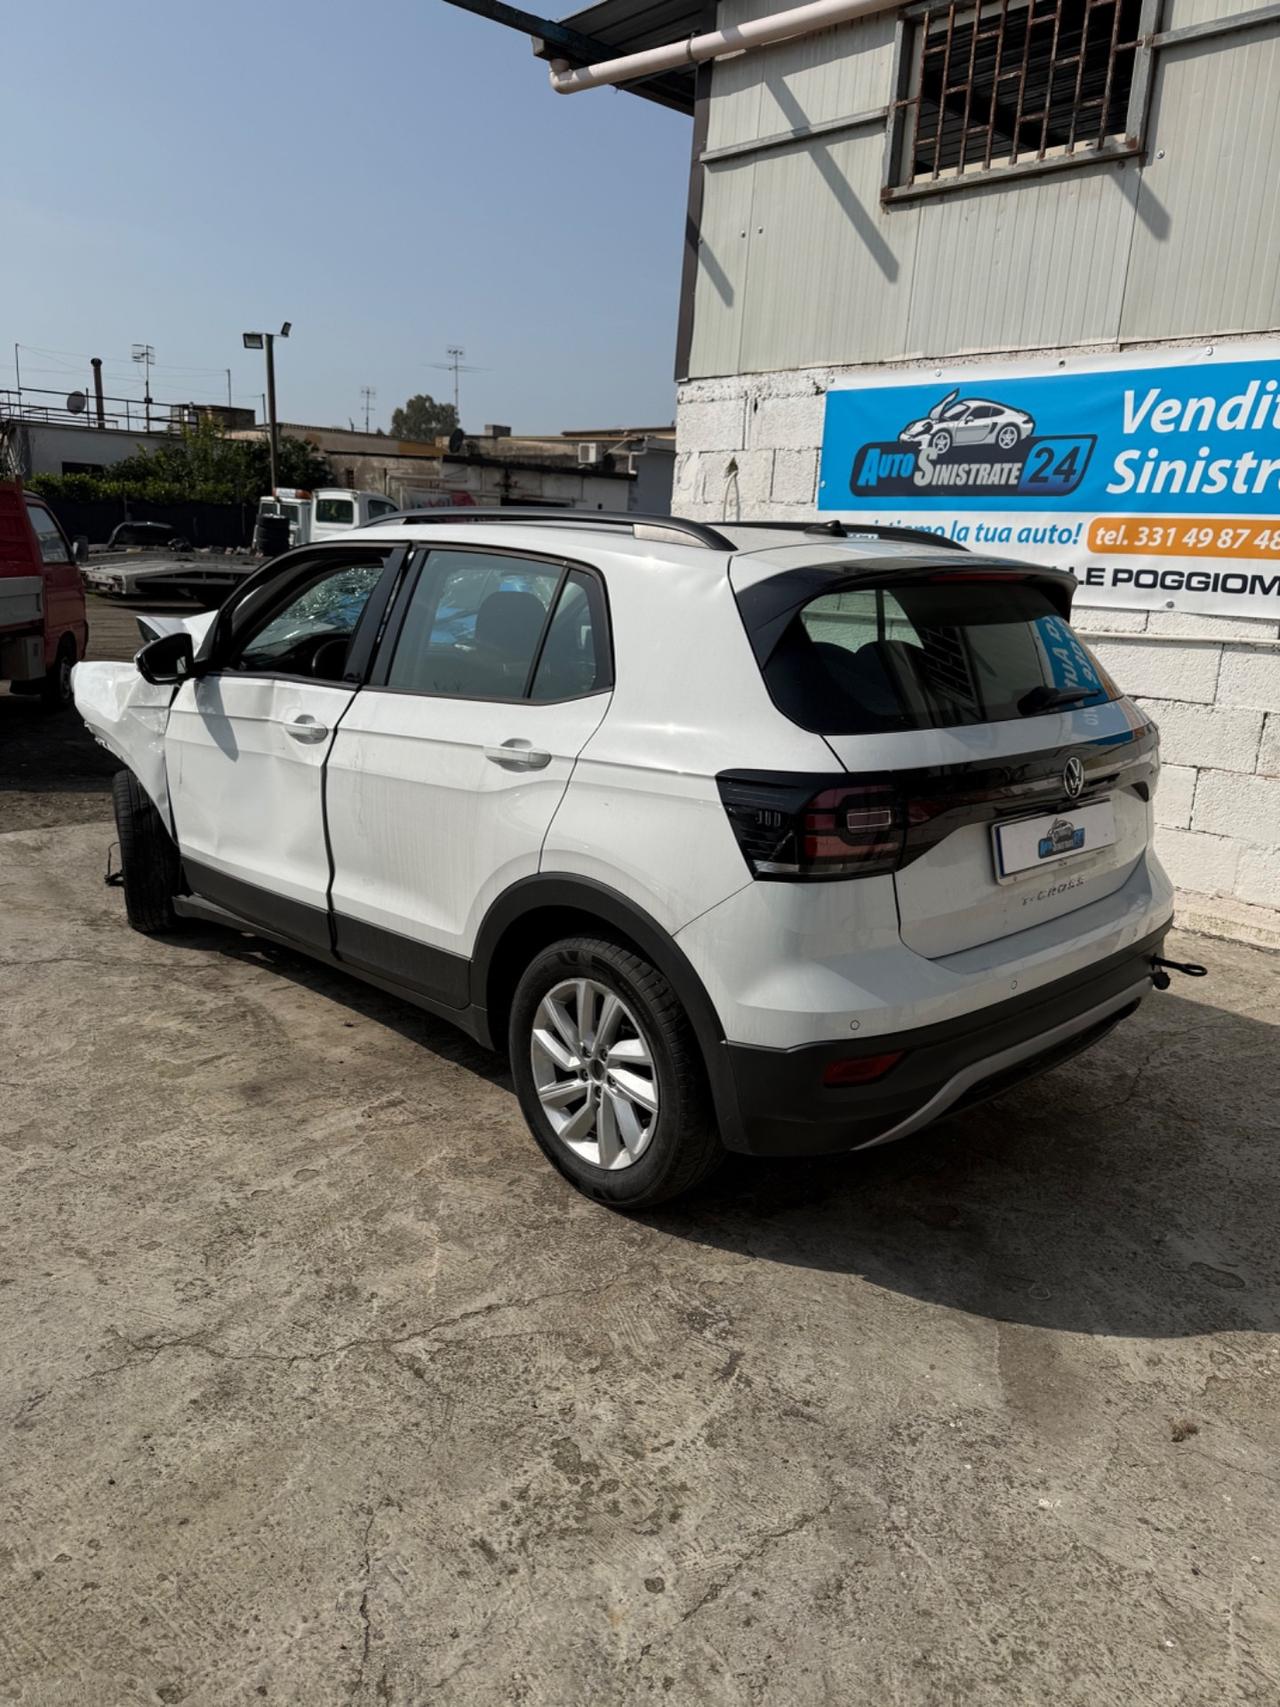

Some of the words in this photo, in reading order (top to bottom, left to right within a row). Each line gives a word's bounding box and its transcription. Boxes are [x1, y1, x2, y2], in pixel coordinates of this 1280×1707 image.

[1028, 446, 1081, 484] 24
[1105, 446, 1280, 494] Sinistr
[950, 520, 970, 543] la
[974, 522, 1011, 544] tua
[1016, 522, 1083, 545] auto!
[1095, 525, 1128, 546] tel.
[1134, 526, 1177, 547] 331
[1182, 527, 1213, 548] 49
[1216, 527, 1251, 549] 87
[1112, 568, 1280, 596] POGGIOM
